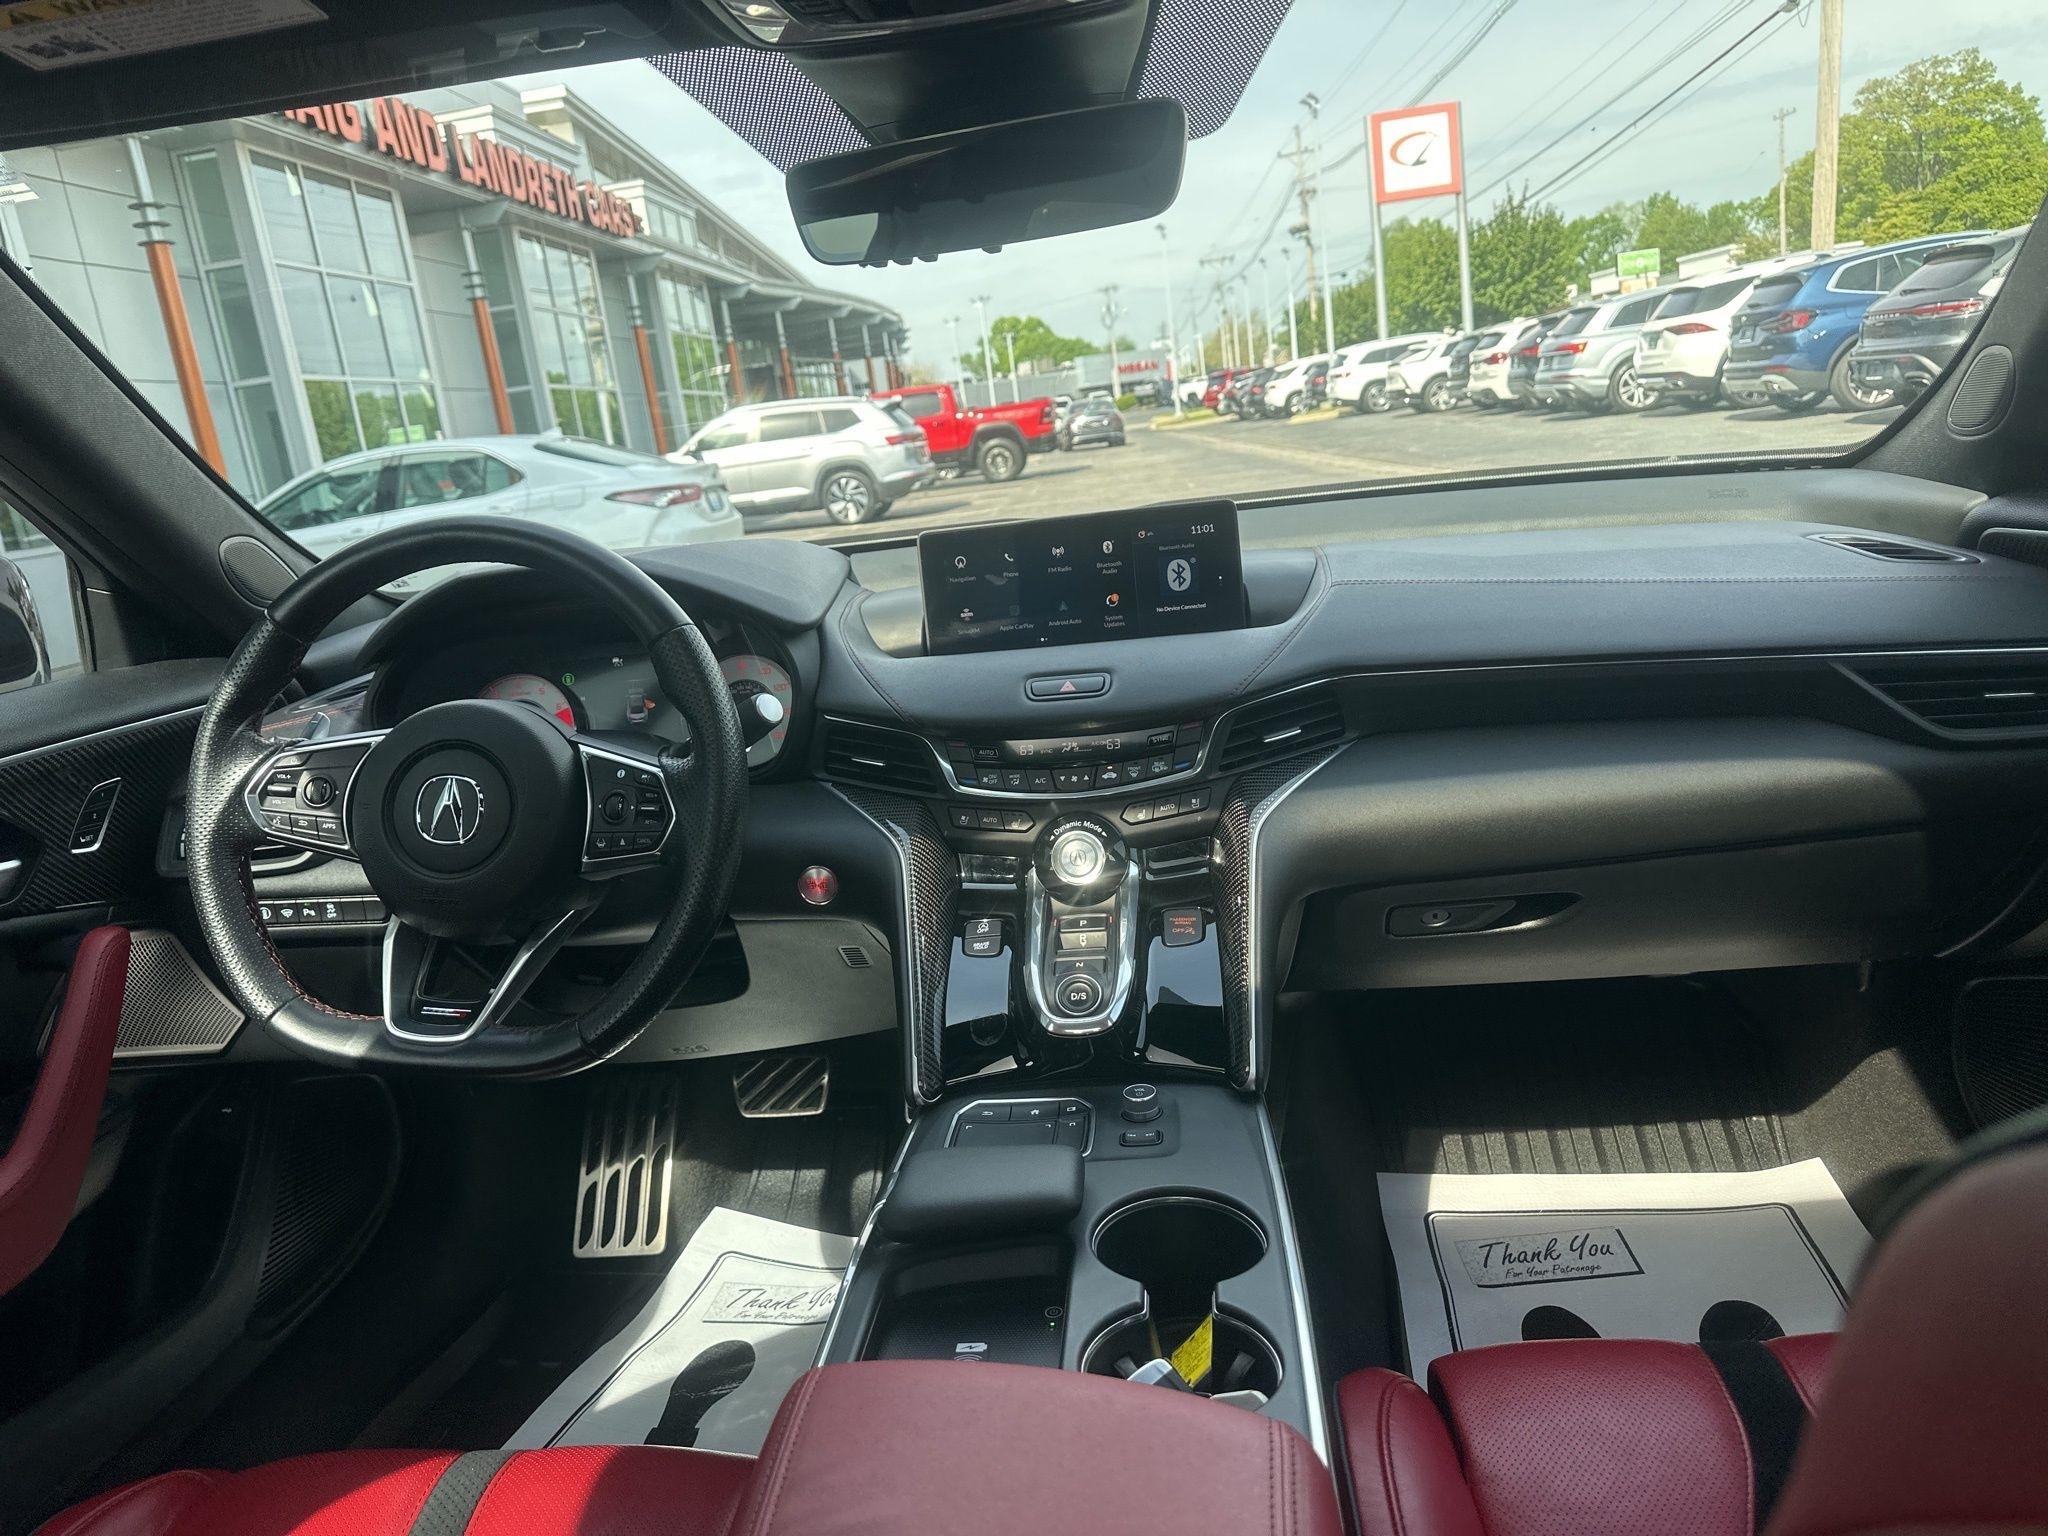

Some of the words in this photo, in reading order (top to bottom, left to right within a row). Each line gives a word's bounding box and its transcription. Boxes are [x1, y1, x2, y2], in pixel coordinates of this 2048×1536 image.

[283, 102, 362, 144] AIG
[373, 97, 448, 174] AND
[451, 122, 583, 222] LANDRETH
[584, 181, 635, 238] CARS
[1190, 523, 1215, 535] 11:01
[1180, 603, 1207, 611] Connected
[1048, 620, 1069, 628] Android
[1103, 621, 1126, 629] Updates
[1106, 738, 1121, 750] 63
[978, 748, 995, 756] AUTO
[1019, 744, 1034, 756] 63
[1159, 803, 1175, 812] AUTO
[322, 822, 337, 830] APPS
[1053, 820, 1082, 836] Dynamic
[1082, 820, 1103, 833] Mode
[1079, 919, 1088, 927] P
[1070, 991, 1088, 1001] D/S
[1478, 1237, 1562, 1269] Thank
[1569, 1233, 1615, 1260] You
[1505, 1267, 1523, 1279] For
[1526, 1266, 1549, 1277] Your
[1552, 1263, 1602, 1275] Patronage
[726, 1287, 809, 1311] Thank
